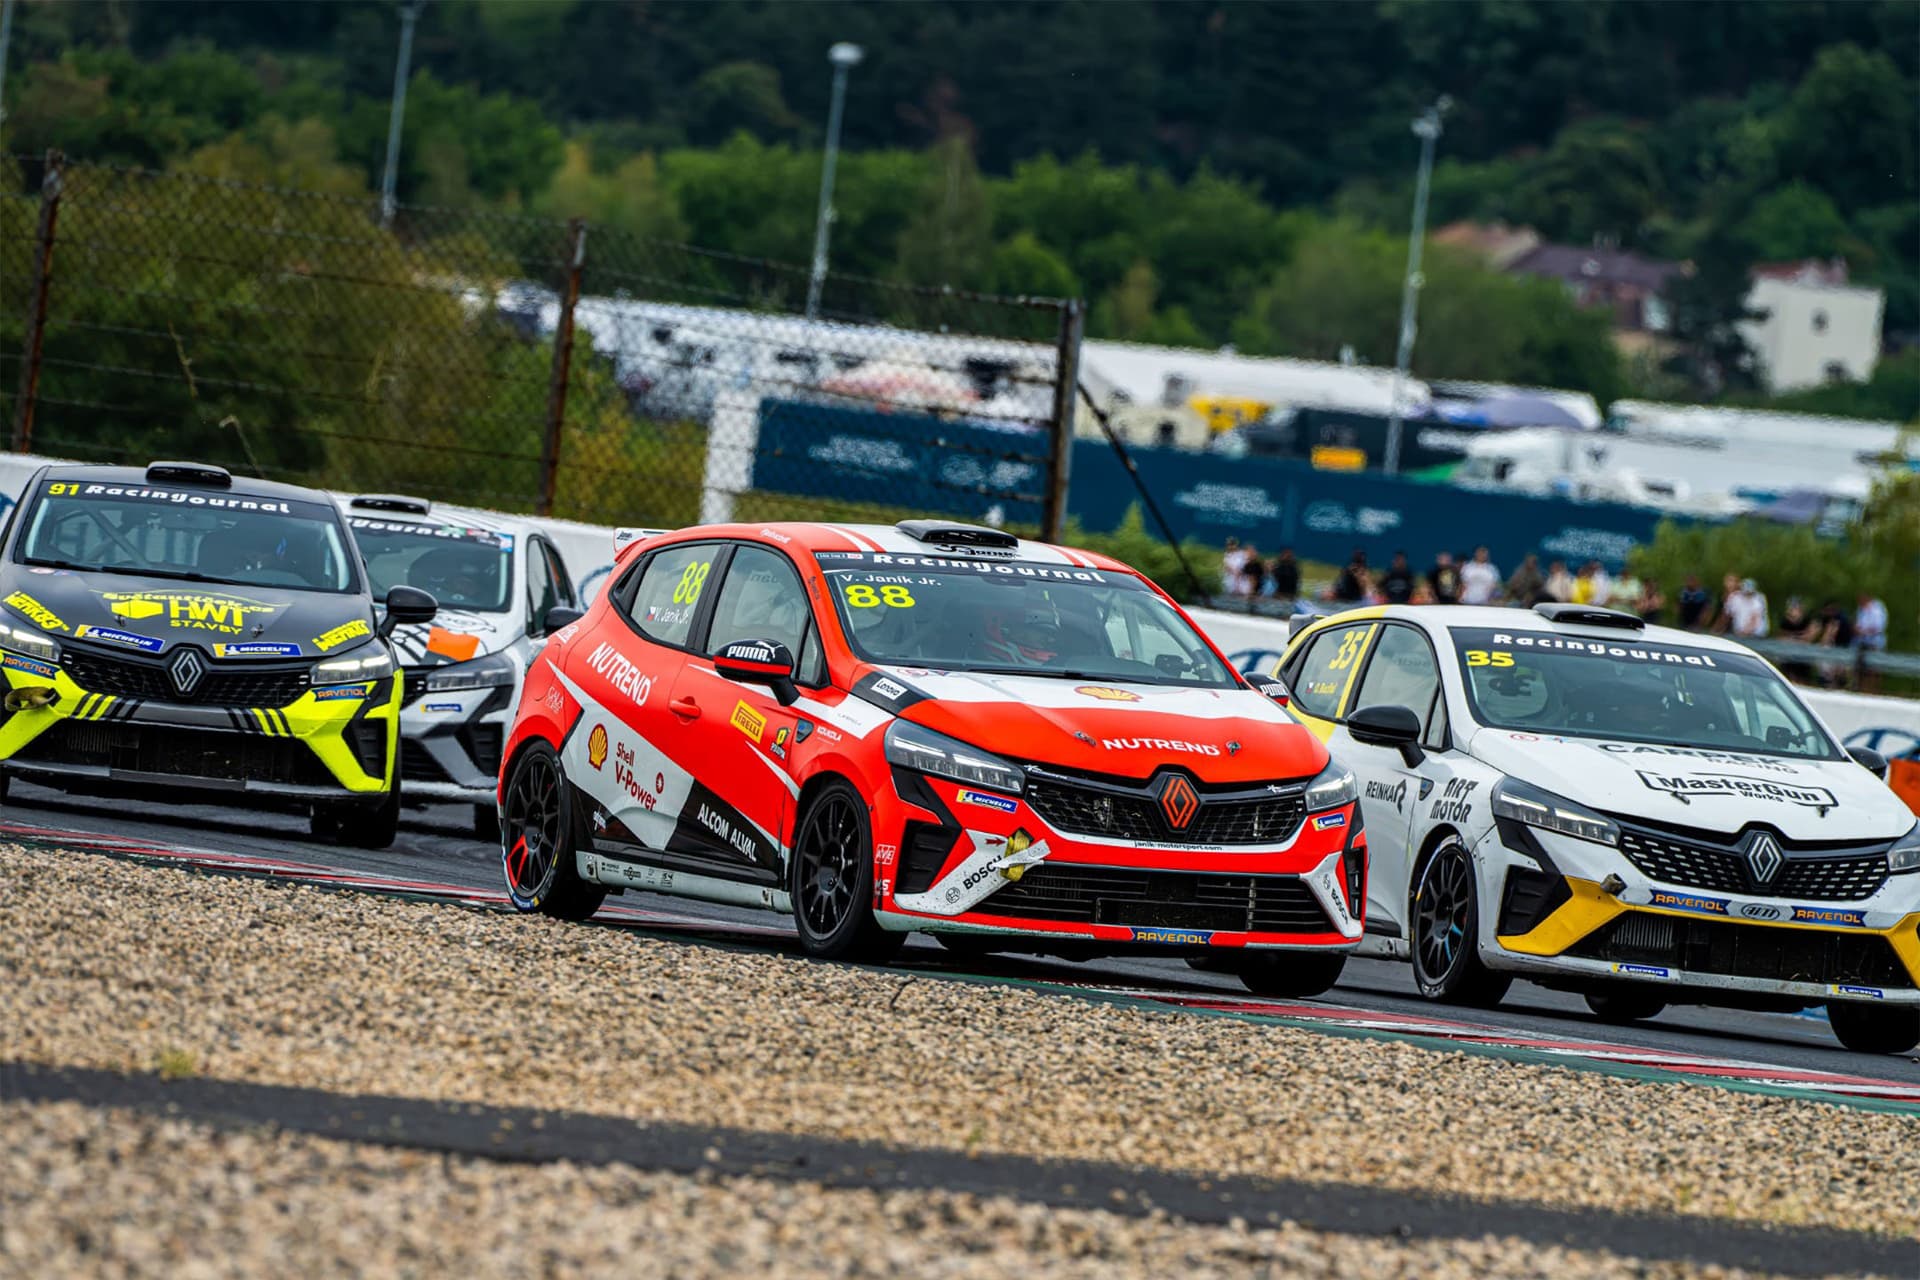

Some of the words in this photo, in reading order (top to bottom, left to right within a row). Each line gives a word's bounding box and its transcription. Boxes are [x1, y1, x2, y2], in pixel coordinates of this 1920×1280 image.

[48, 483, 80, 496] 91
[673, 561, 710, 604] 88
[845, 585, 916, 608] 88
[169, 599, 243, 627] HWT
[170, 619, 243, 635] STAVBY
[101, 631, 153, 646] MICHELIN
[726, 646, 769, 661] PUMA
[1328, 630, 1366, 670] 35
[1465, 650, 1515, 667] 35
[5, 656, 53, 677] RAVENOL
[586, 641, 651, 706] NUTREND
[317, 688, 366, 698] RAVENOL
[735, 707, 762, 737] PIRELLI
[616, 741, 635, 767] Shell
[1102, 738, 1220, 756] NUTREND
[615, 760, 657, 812] V-Power
[1656, 777, 1821, 802] MasterGun
[1741, 789, 1785, 803] Works
[974, 796, 1013, 810] MICHELIN
[1429, 799, 1472, 823] MOTOR
[697, 803, 729, 841] ALCOM
[729, 828, 757, 863] ALVAL
[1331, 888, 1348, 925] BOSCH
[1655, 893, 1725, 912] RAVENOL
[1796, 909, 1861, 924] RAVENOL
[1136, 931, 1207, 945] RAVENOL
